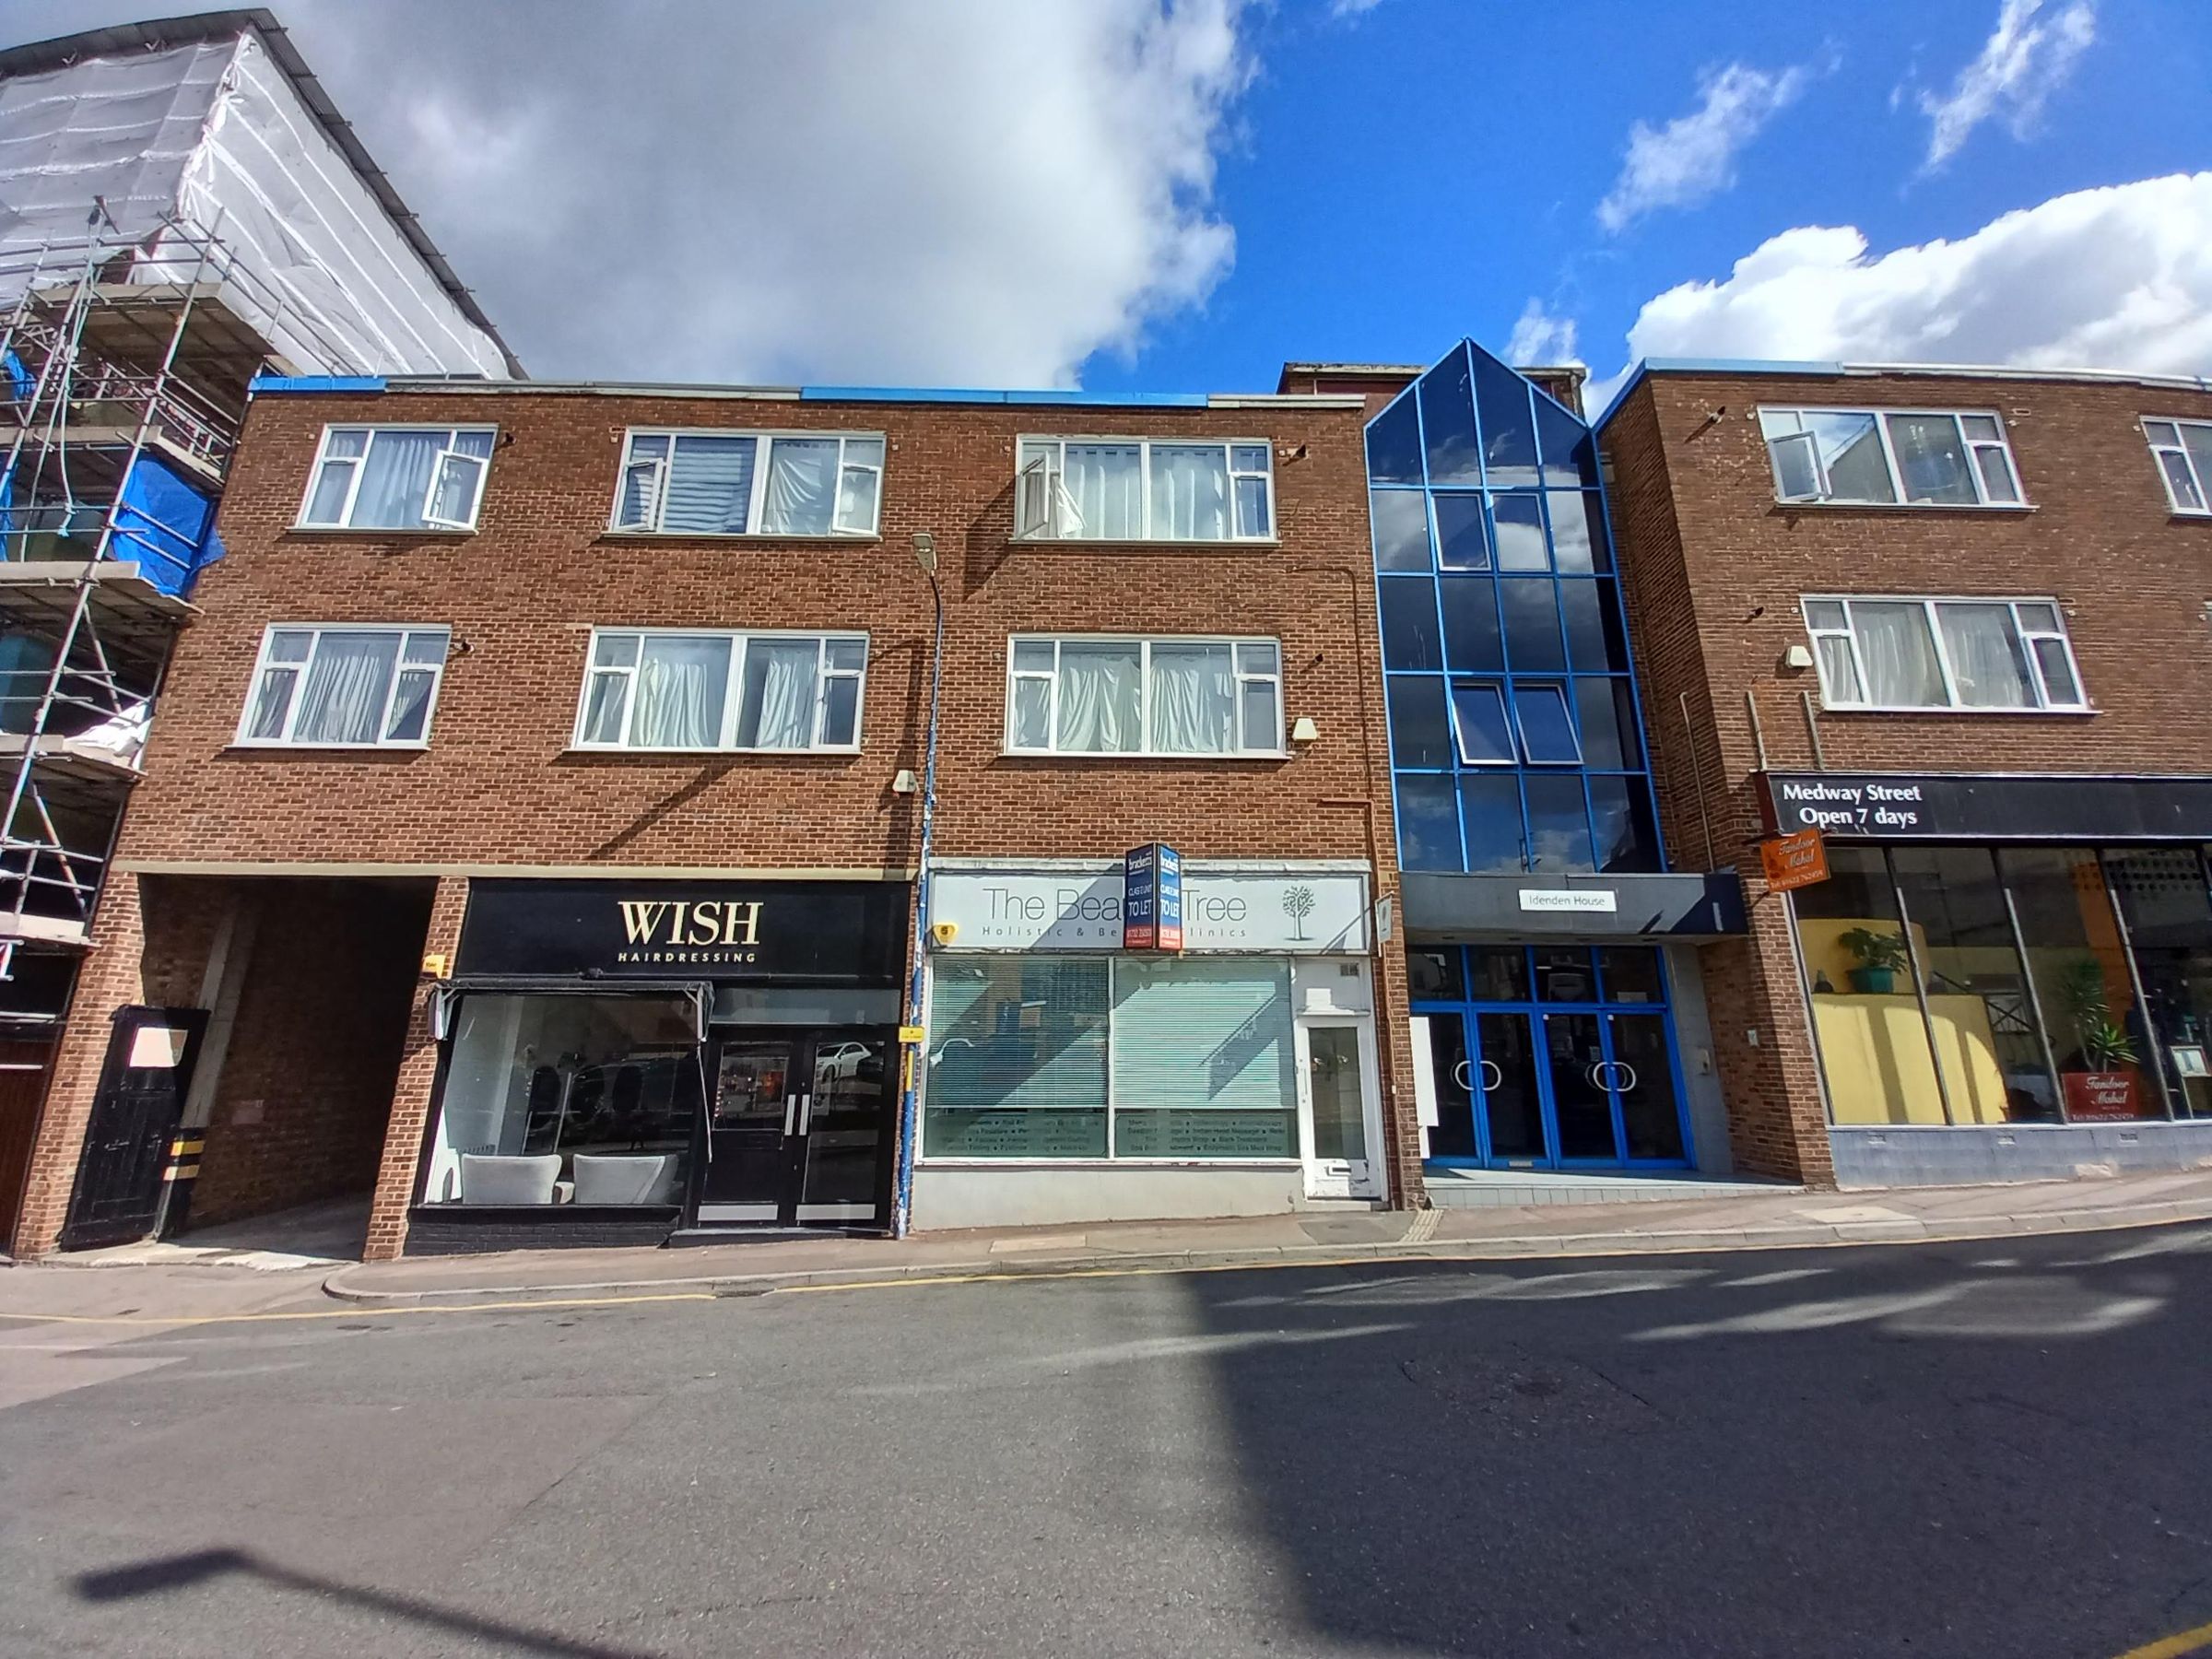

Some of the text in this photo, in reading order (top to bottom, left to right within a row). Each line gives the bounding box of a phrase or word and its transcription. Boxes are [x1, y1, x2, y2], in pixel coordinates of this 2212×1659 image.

[1783, 783, 1923, 805] Medway Street
[1799, 806, 1918, 830] Open 7 days
[982, 888, 1125, 921] The Bea
[1128, 899, 1152, 917] TO LET
[1160, 899, 1180, 919] TO LET
[1182, 889, 1246, 922] Tree
[1529, 895, 1606, 906] Idenden House
[618, 901, 764, 946] WISH
[982, 927, 1063, 936] Holistic
[1077, 927, 1084, 936] &
[1099, 927, 1117, 936] Be
[1190, 927, 1246, 937] linics
[618, 952, 756, 963] HAIRDRESSING
